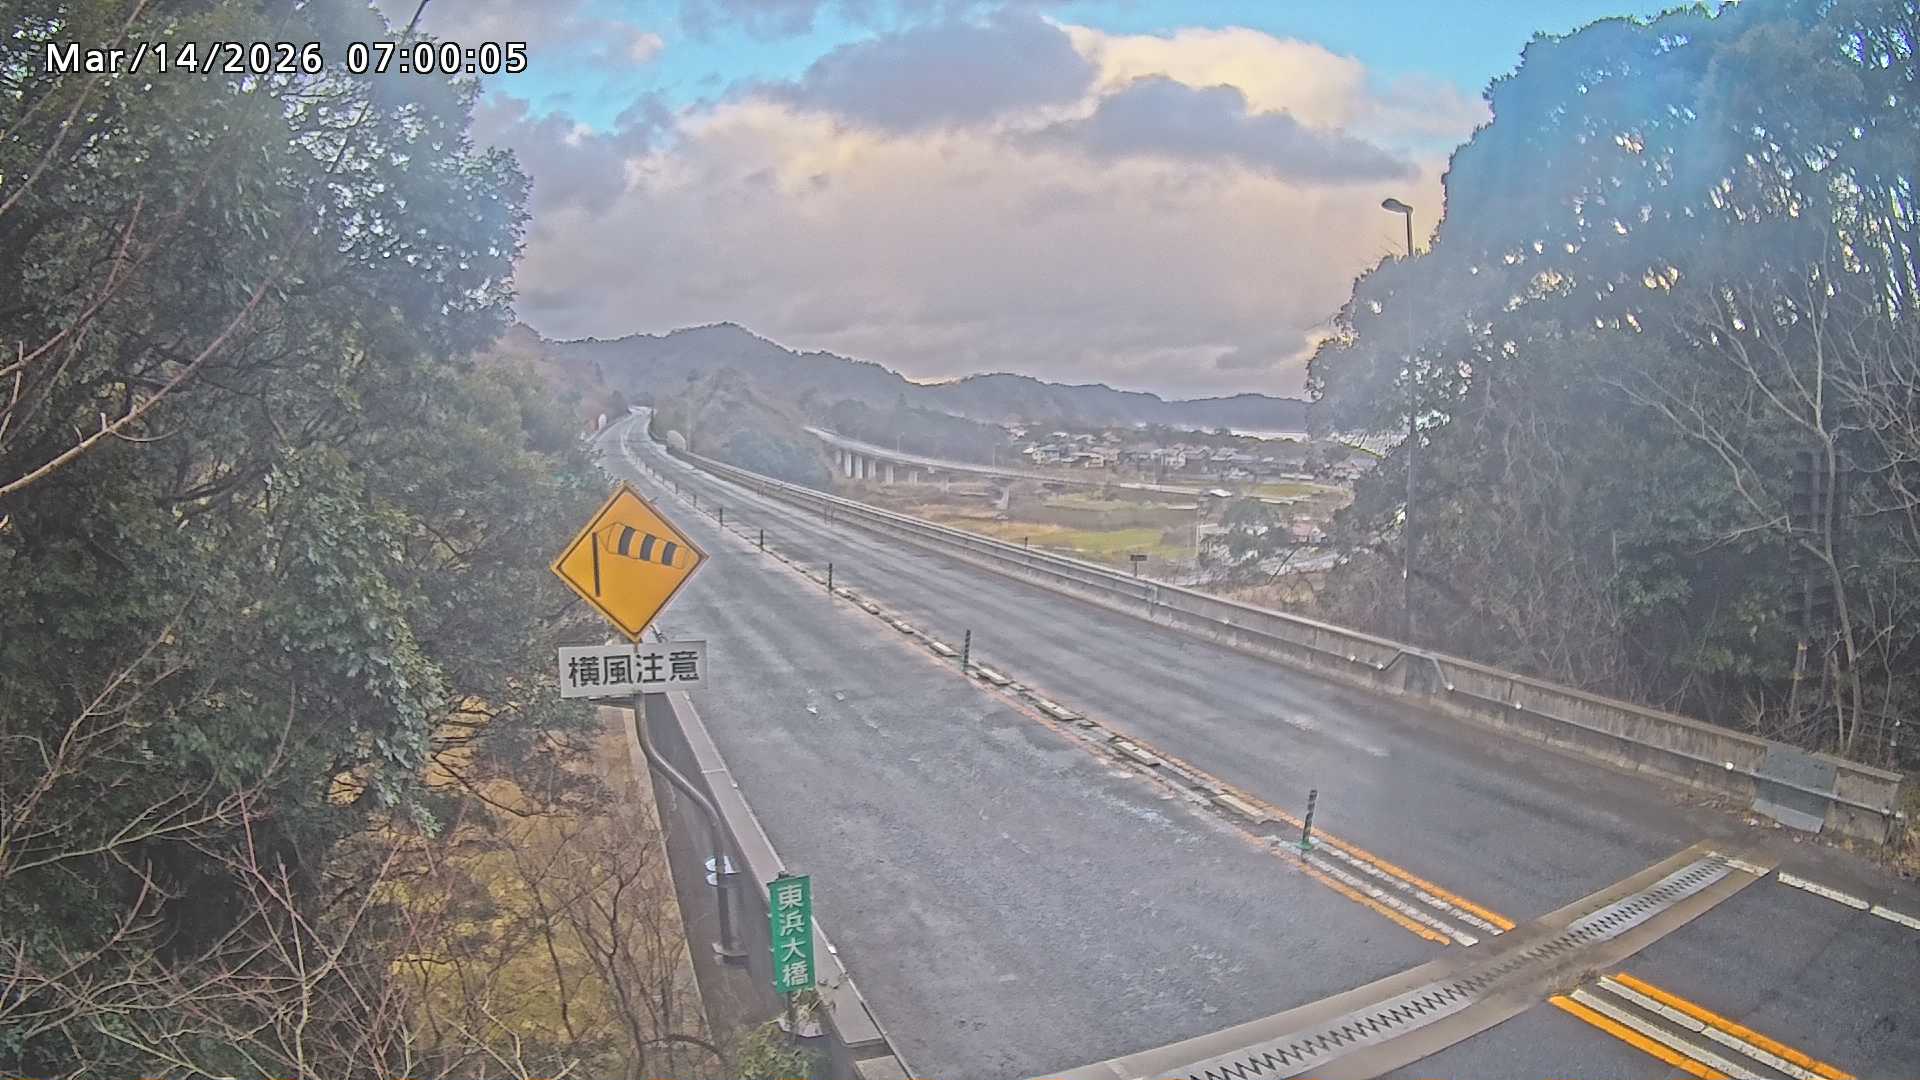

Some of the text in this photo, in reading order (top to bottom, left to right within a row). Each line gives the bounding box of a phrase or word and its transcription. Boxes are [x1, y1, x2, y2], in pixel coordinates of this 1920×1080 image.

[568, 651, 699, 687] 横風注意
[777, 884, 808, 987] 東浜大橋
